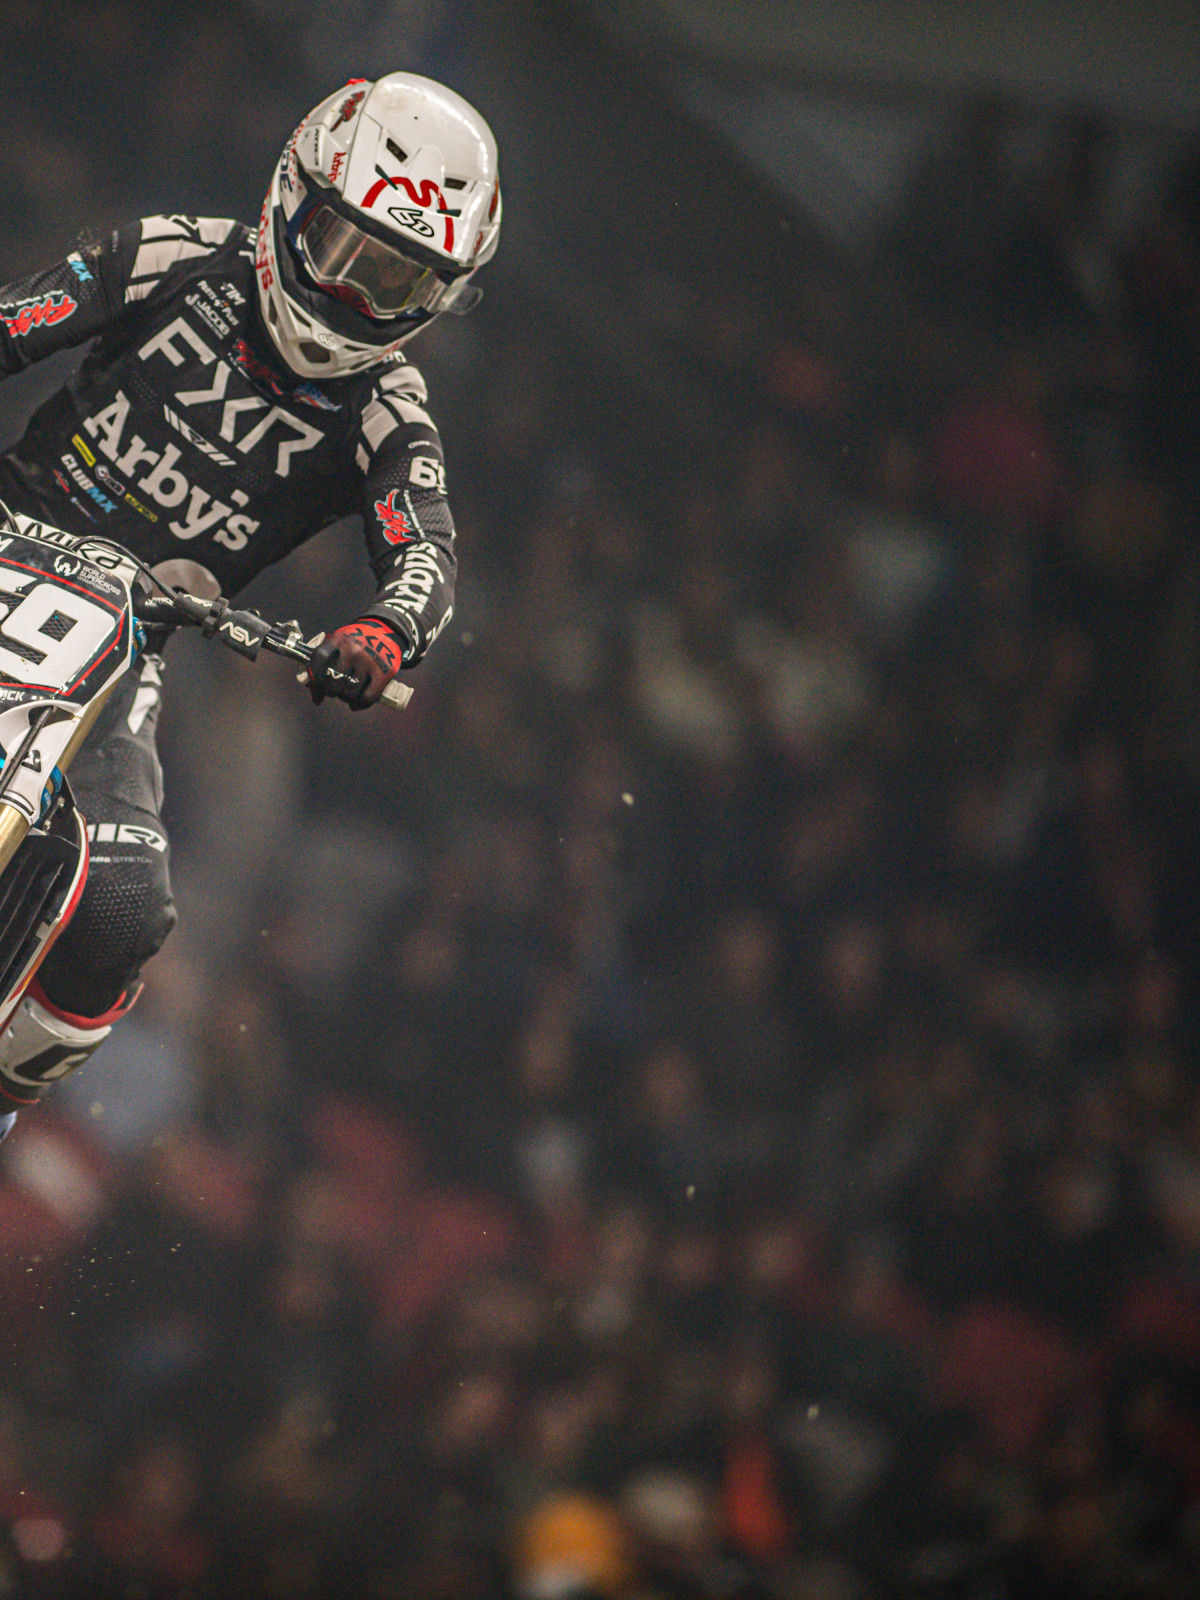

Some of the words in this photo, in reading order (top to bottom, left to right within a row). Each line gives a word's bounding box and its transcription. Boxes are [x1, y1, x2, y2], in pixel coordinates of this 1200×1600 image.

[196, 300, 231, 336] JACOB
[137, 316, 326, 478] FXR
[60, 453, 118, 514] CLUBMX
[82, 389, 261, 551] Arby's
[79, 570, 122, 596] SUPERCROSS
[82, 565, 106, 580] WORLD
[382, 541, 445, 615] Arby's
[219, 621, 260, 648] ASV
